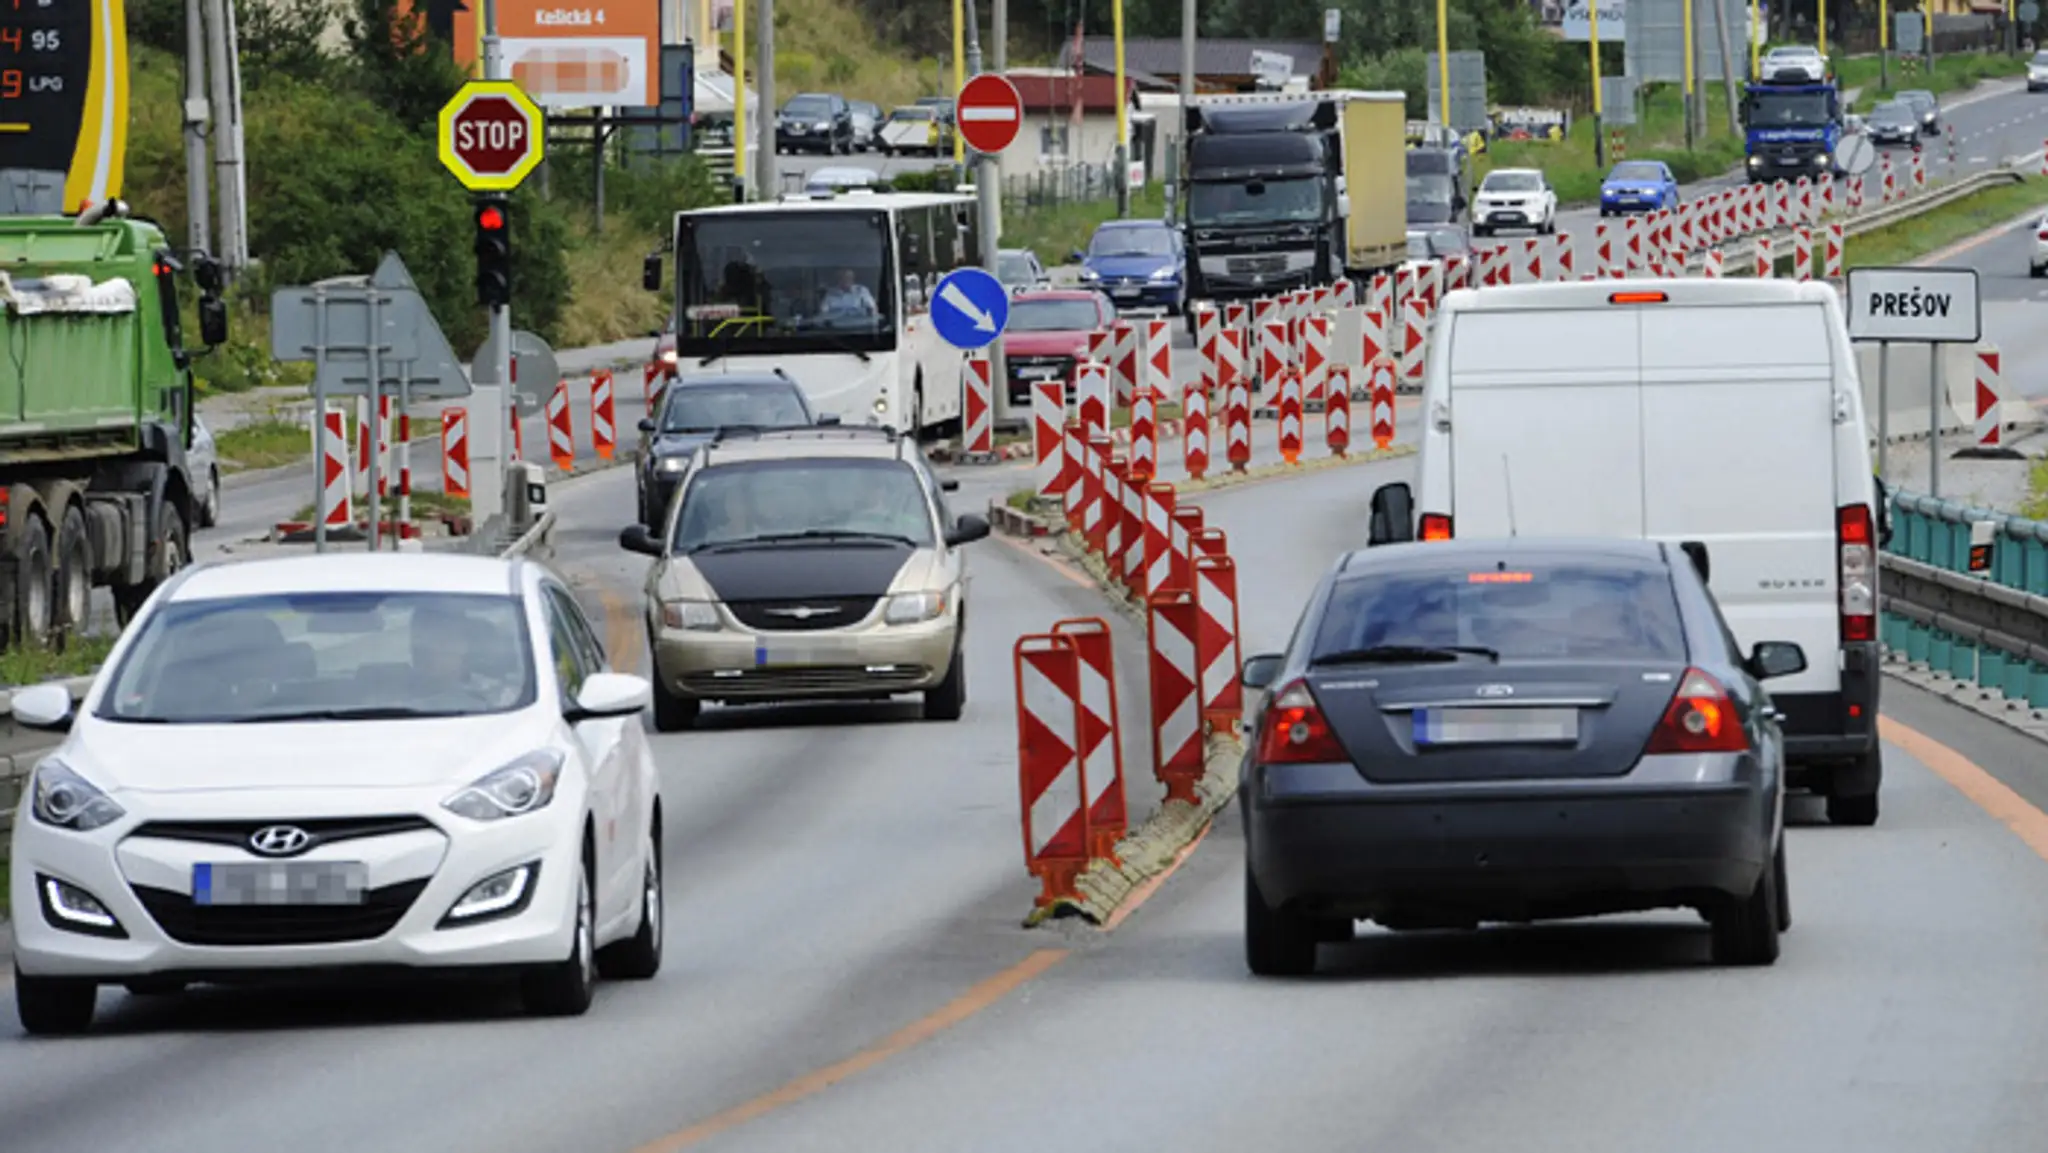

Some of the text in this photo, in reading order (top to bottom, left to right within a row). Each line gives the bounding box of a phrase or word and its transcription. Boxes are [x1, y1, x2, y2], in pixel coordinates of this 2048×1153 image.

[594, 8, 606, 25] 4
[2, 27, 60, 54] 4 95
[2, 69, 22, 98] 9
[458, 120, 524, 151] STOP
[1870, 286, 1951, 317] PREŠOV
